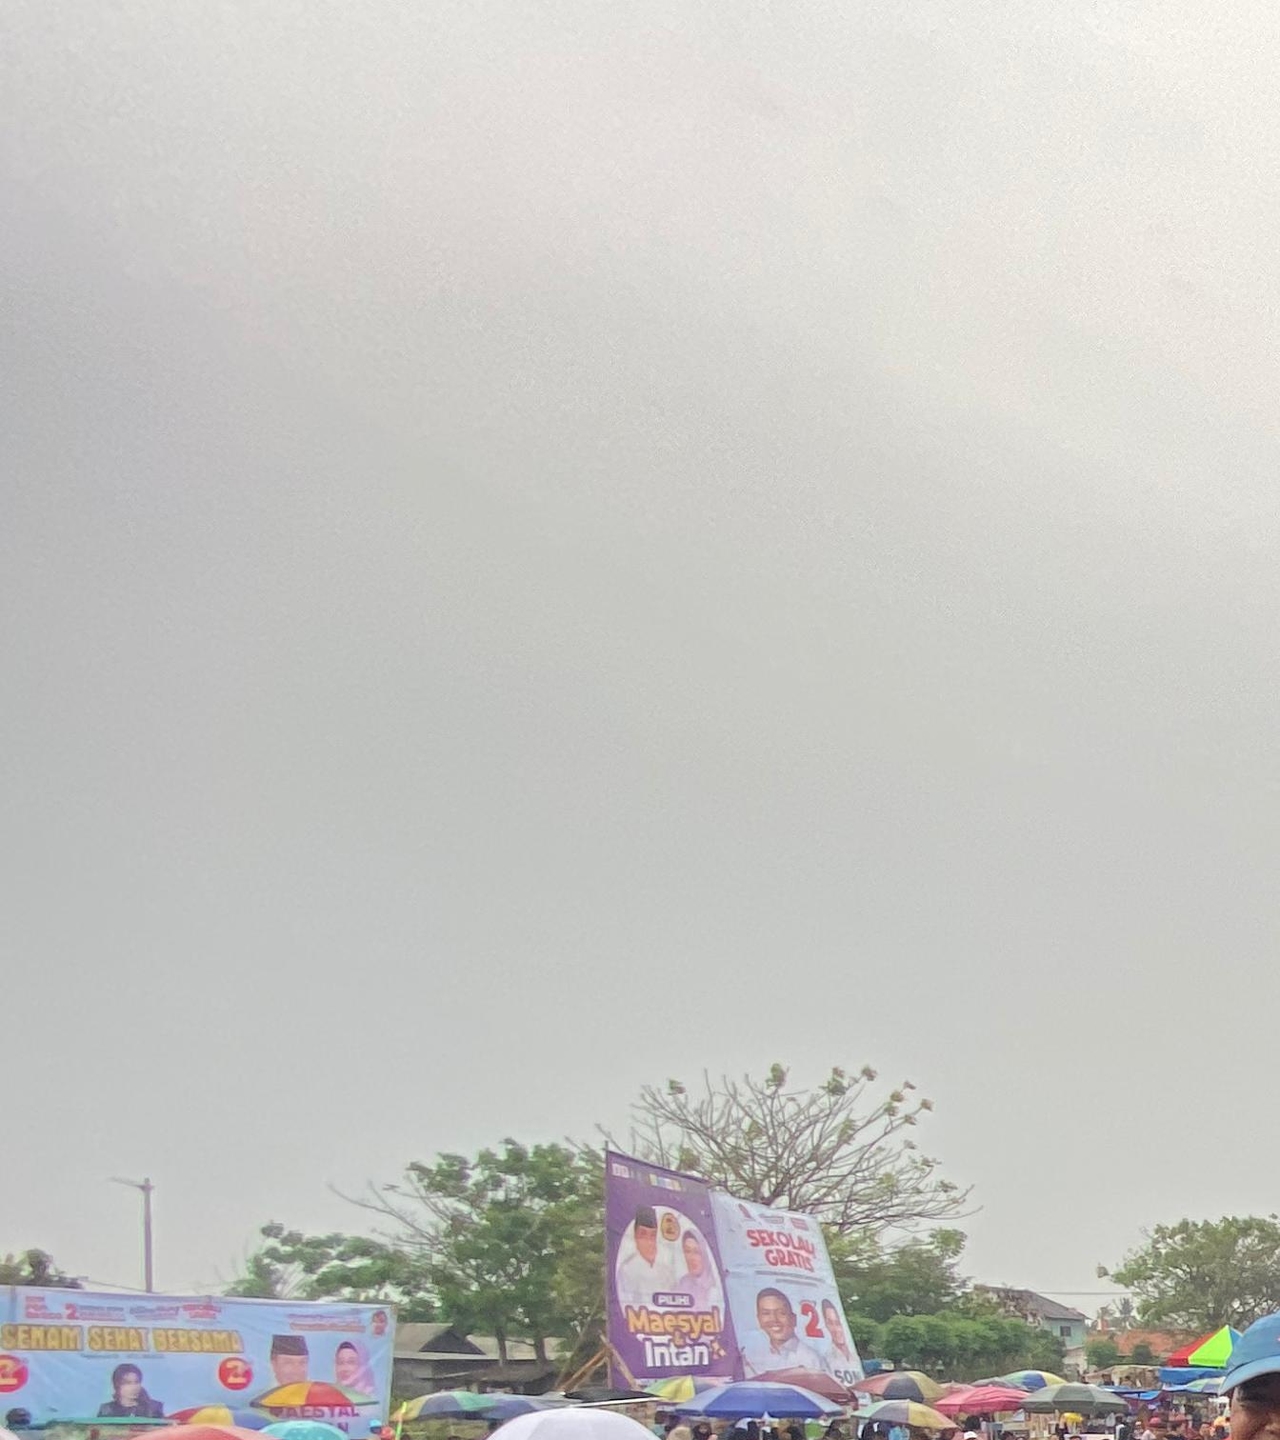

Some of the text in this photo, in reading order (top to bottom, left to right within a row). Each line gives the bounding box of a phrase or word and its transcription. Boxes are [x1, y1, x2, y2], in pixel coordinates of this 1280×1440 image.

[765, 1249, 815, 1272] GRATIS
[627, 1306, 721, 1337] Maesyal
[801, 1301, 824, 1338] 2
[88, 1326, 148, 1351] SEHAT
[152, 1328, 243, 1353] BERSAMA
[644, 1337, 710, 1368] Intan
